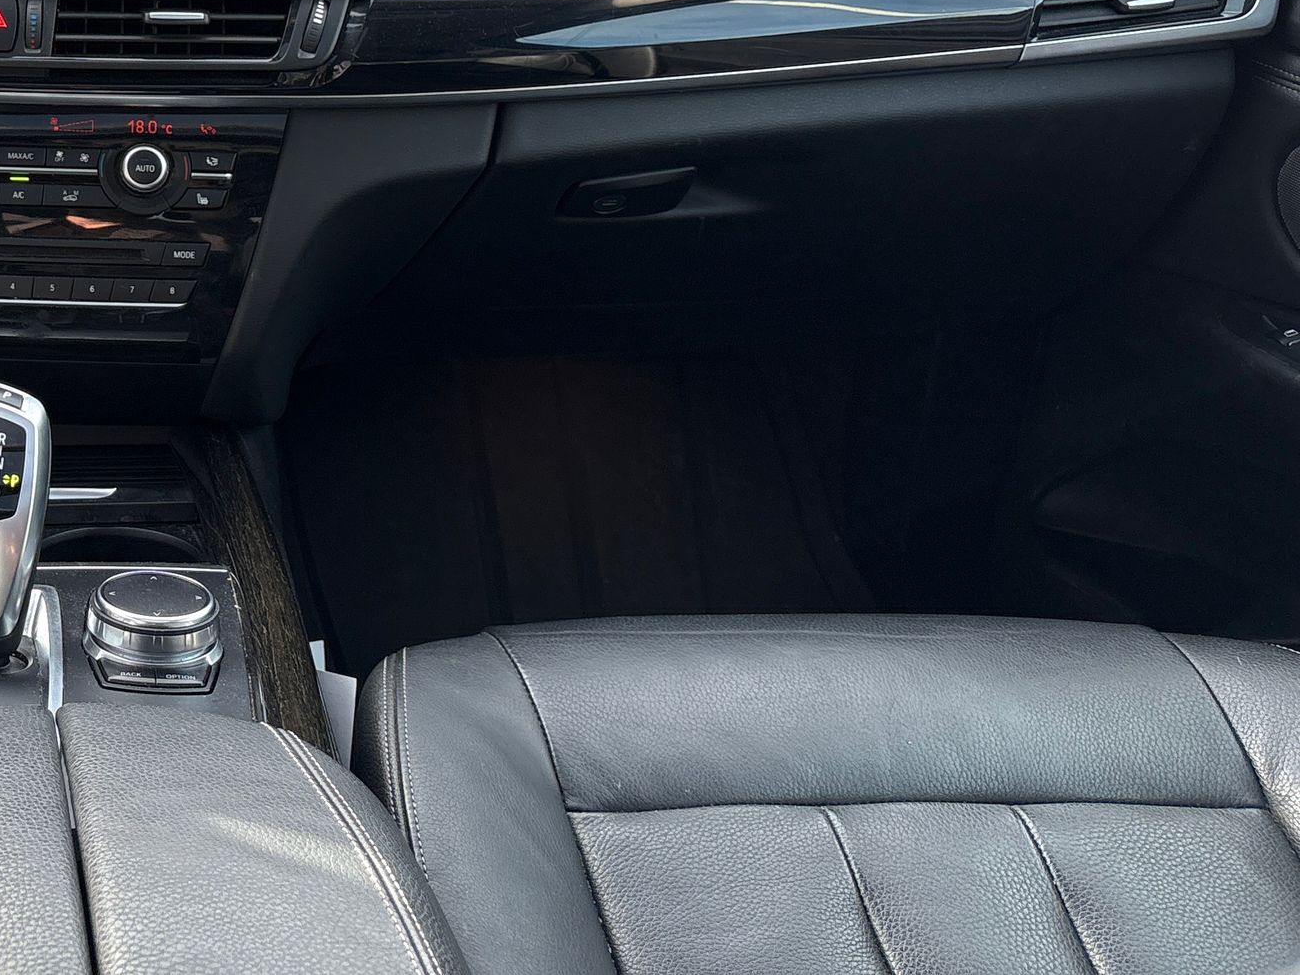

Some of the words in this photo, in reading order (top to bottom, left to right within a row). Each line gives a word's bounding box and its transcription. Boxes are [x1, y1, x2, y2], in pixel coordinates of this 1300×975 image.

[128, 119, 158, 134] 18.0
[135, 164, 156, 173] AUTO
[12, 190, 25, 200] A/C
[173, 251, 196, 259] MODE
[10, 282, 15, 290] 4
[50, 284, 55, 292] 5
[89, 285, 95, 293] 6
[169, 287, 175, 295] 8
[10, 474, 19, 487] P
[165, 673, 196, 681] OPTION
